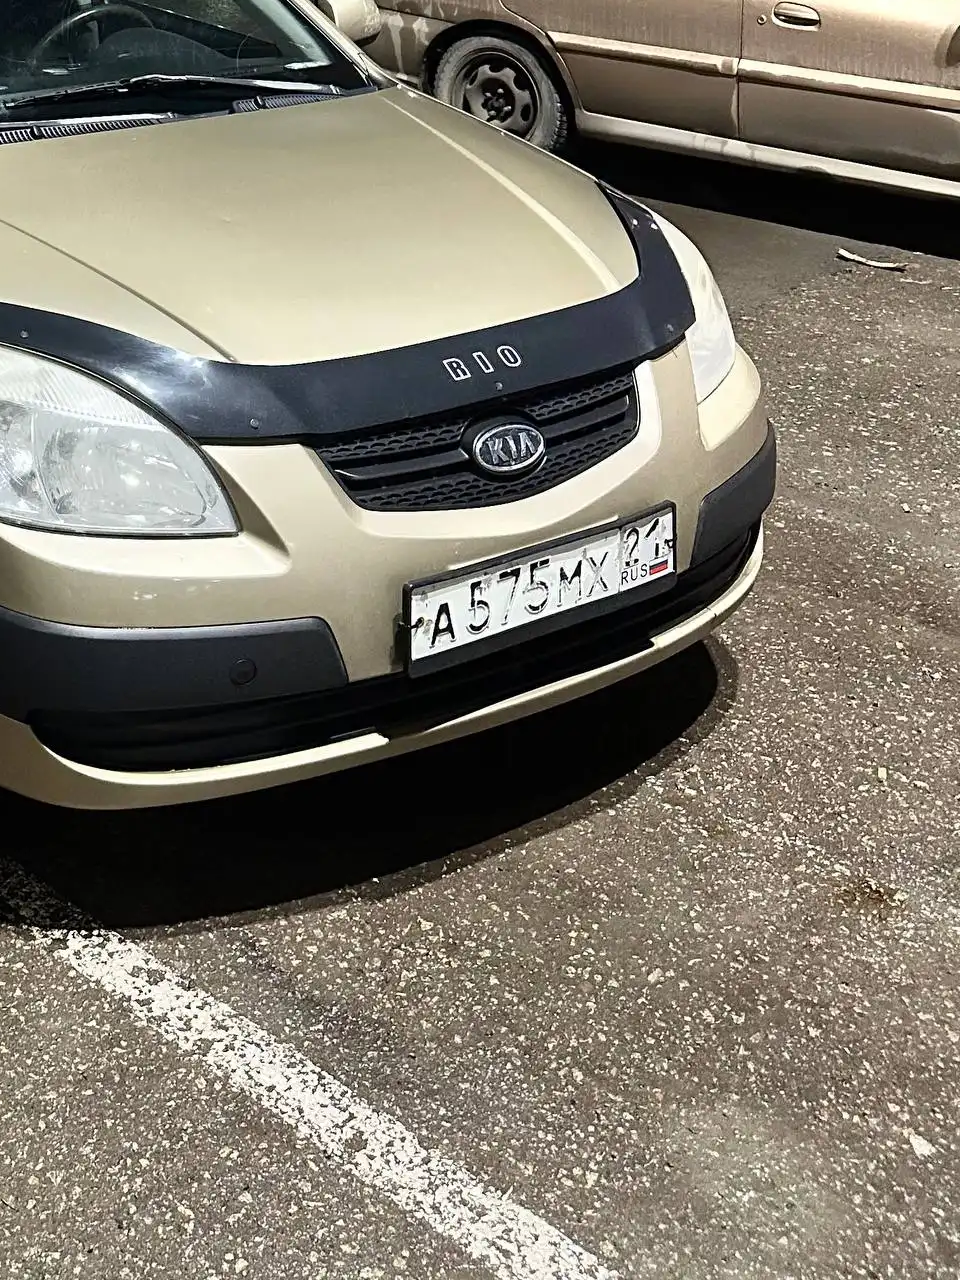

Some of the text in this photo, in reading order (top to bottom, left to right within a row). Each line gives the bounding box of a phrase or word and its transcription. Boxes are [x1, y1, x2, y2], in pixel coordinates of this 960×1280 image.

[442, 345, 522, 381] RIO
[485, 431, 537, 465] KIA
[621, 563, 648, 586] RUS
